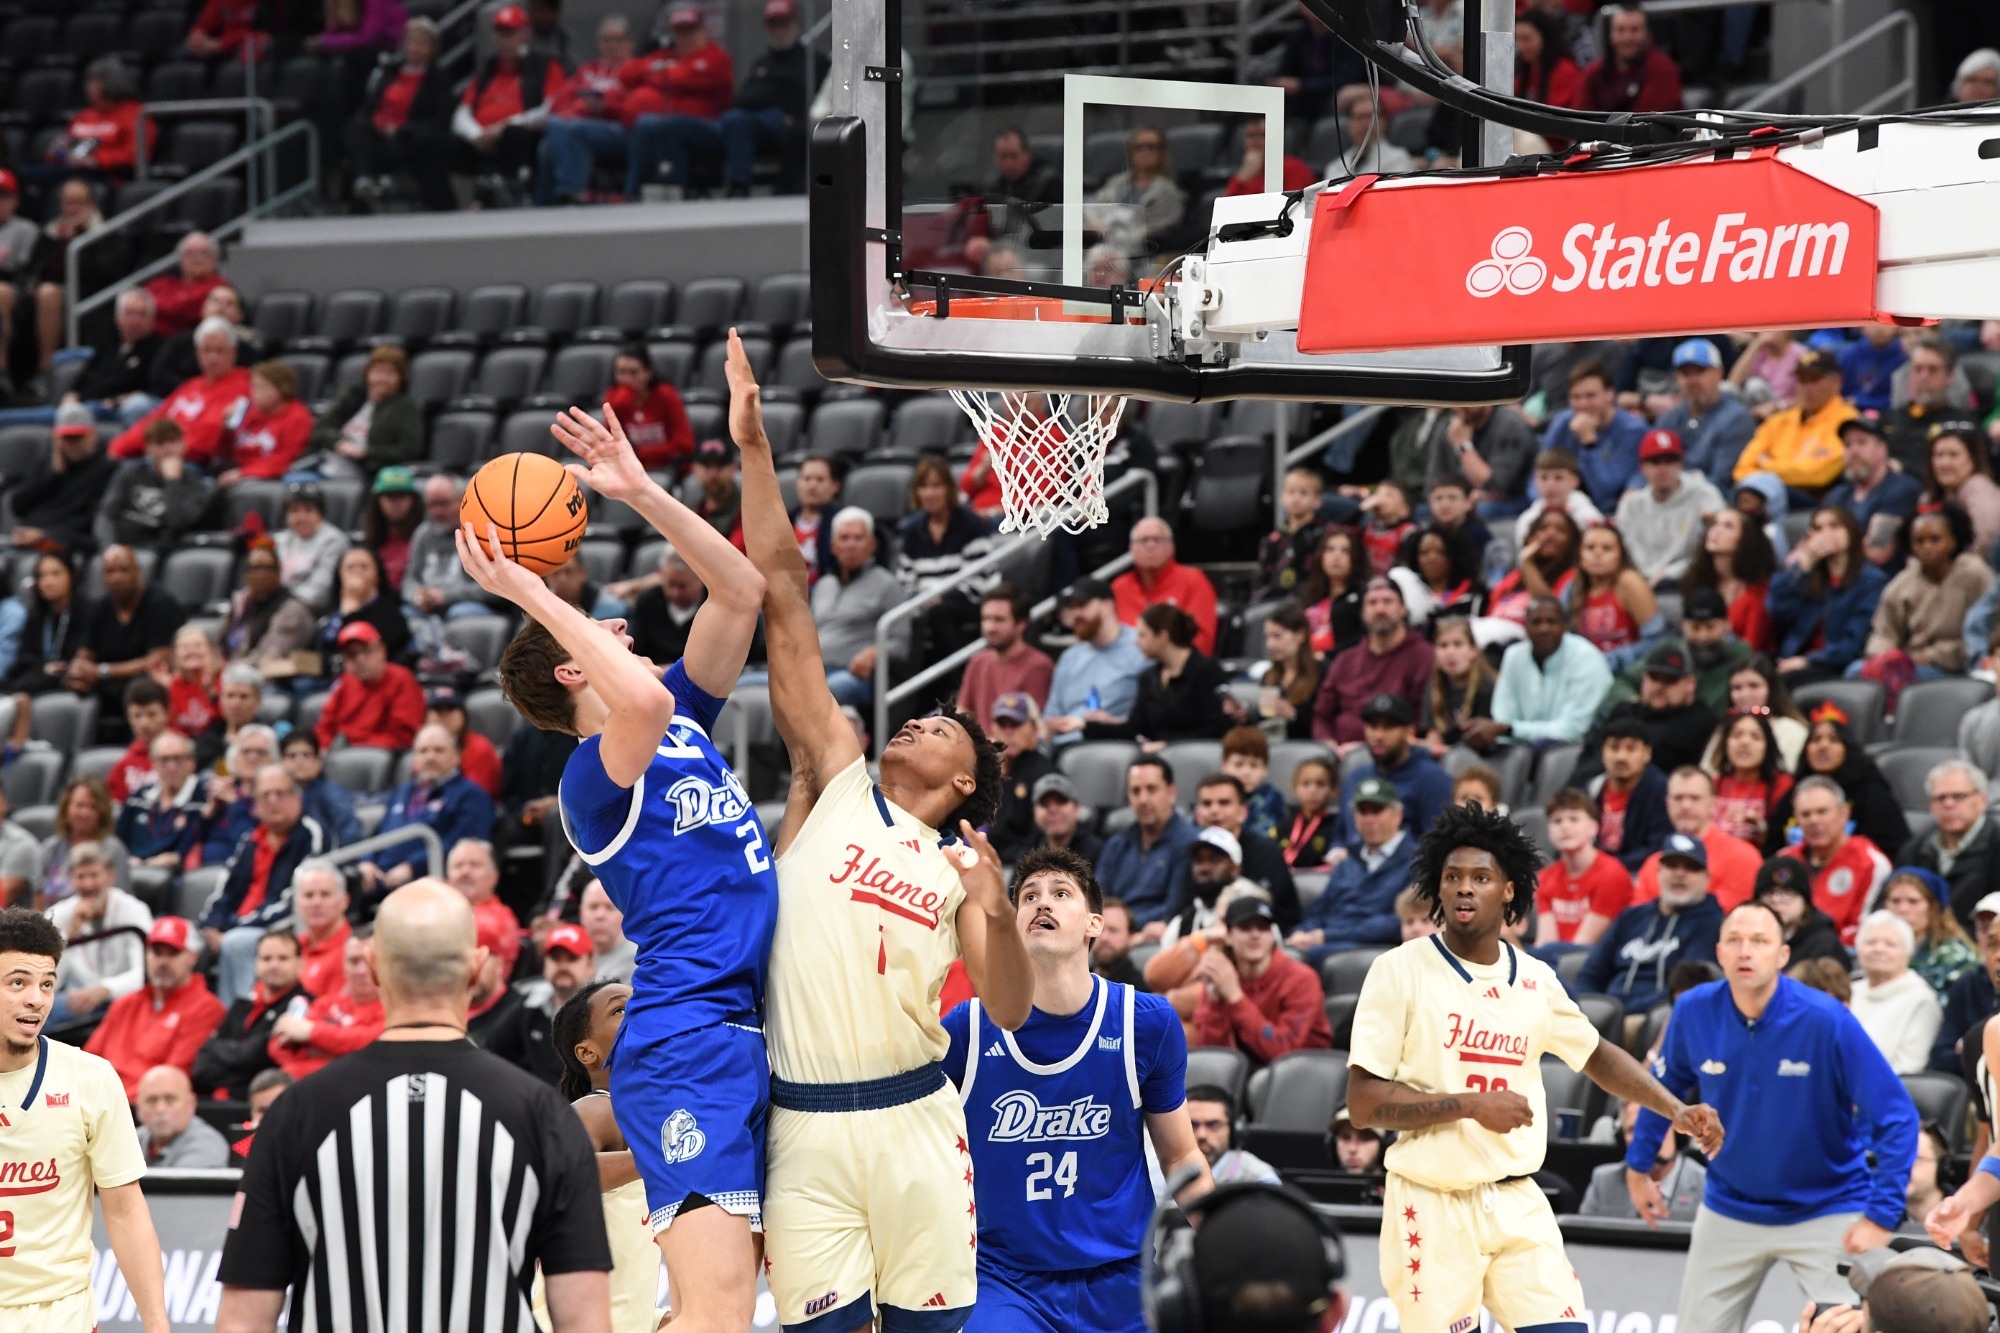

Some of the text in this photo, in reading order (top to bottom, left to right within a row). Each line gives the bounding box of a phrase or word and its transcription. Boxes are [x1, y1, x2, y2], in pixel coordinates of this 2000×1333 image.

[1551, 212, 1850, 293] State Farm
[665, 768, 752, 836] Drak
[736, 820, 770, 874] 2
[1098, 1035, 1122, 1050] VALLEY
[988, 1090, 1111, 1142] Drake
[1026, 1151, 1078, 1201] 24
[804, 1290, 838, 1317] UIC
